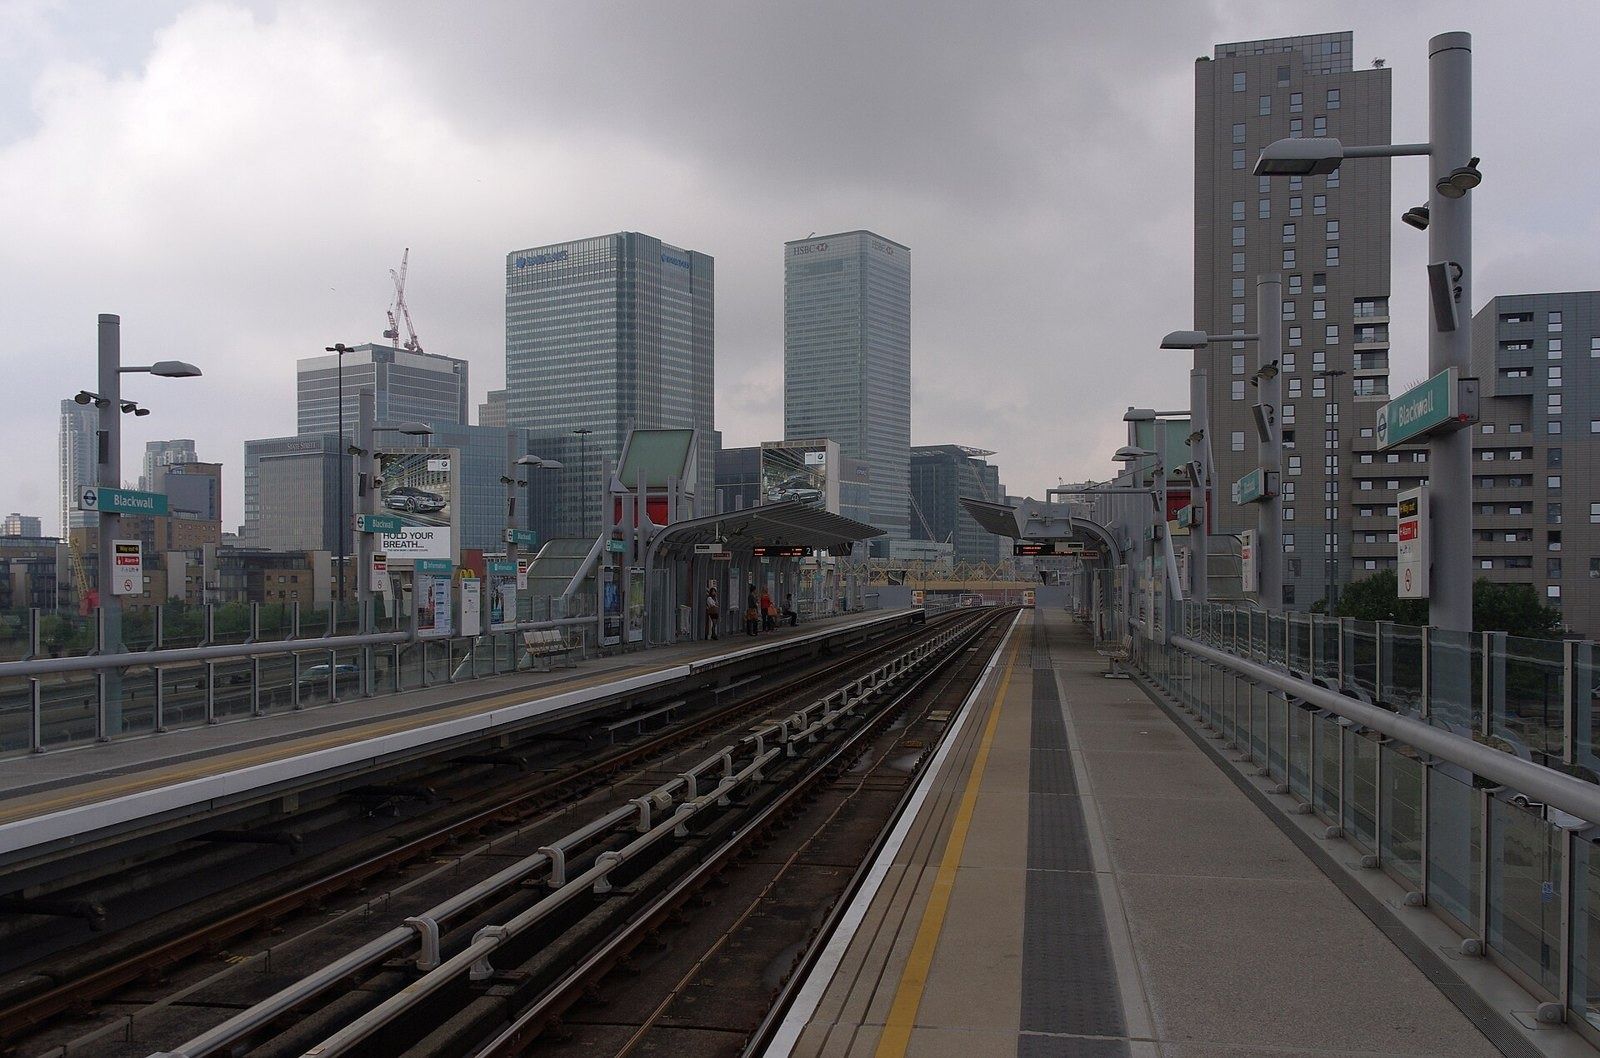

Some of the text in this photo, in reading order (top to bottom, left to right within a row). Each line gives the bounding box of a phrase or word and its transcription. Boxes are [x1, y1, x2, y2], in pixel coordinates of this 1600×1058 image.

[793, 245, 815, 256] HSBC
[1398, 389, 1434, 428] Blackwall
[113, 494, 154, 509] Blackwall
[372, 519, 394, 530] Blackwall
[383, 531, 434, 540] HOLD YOUR
[806, 547, 811, 555] 2
